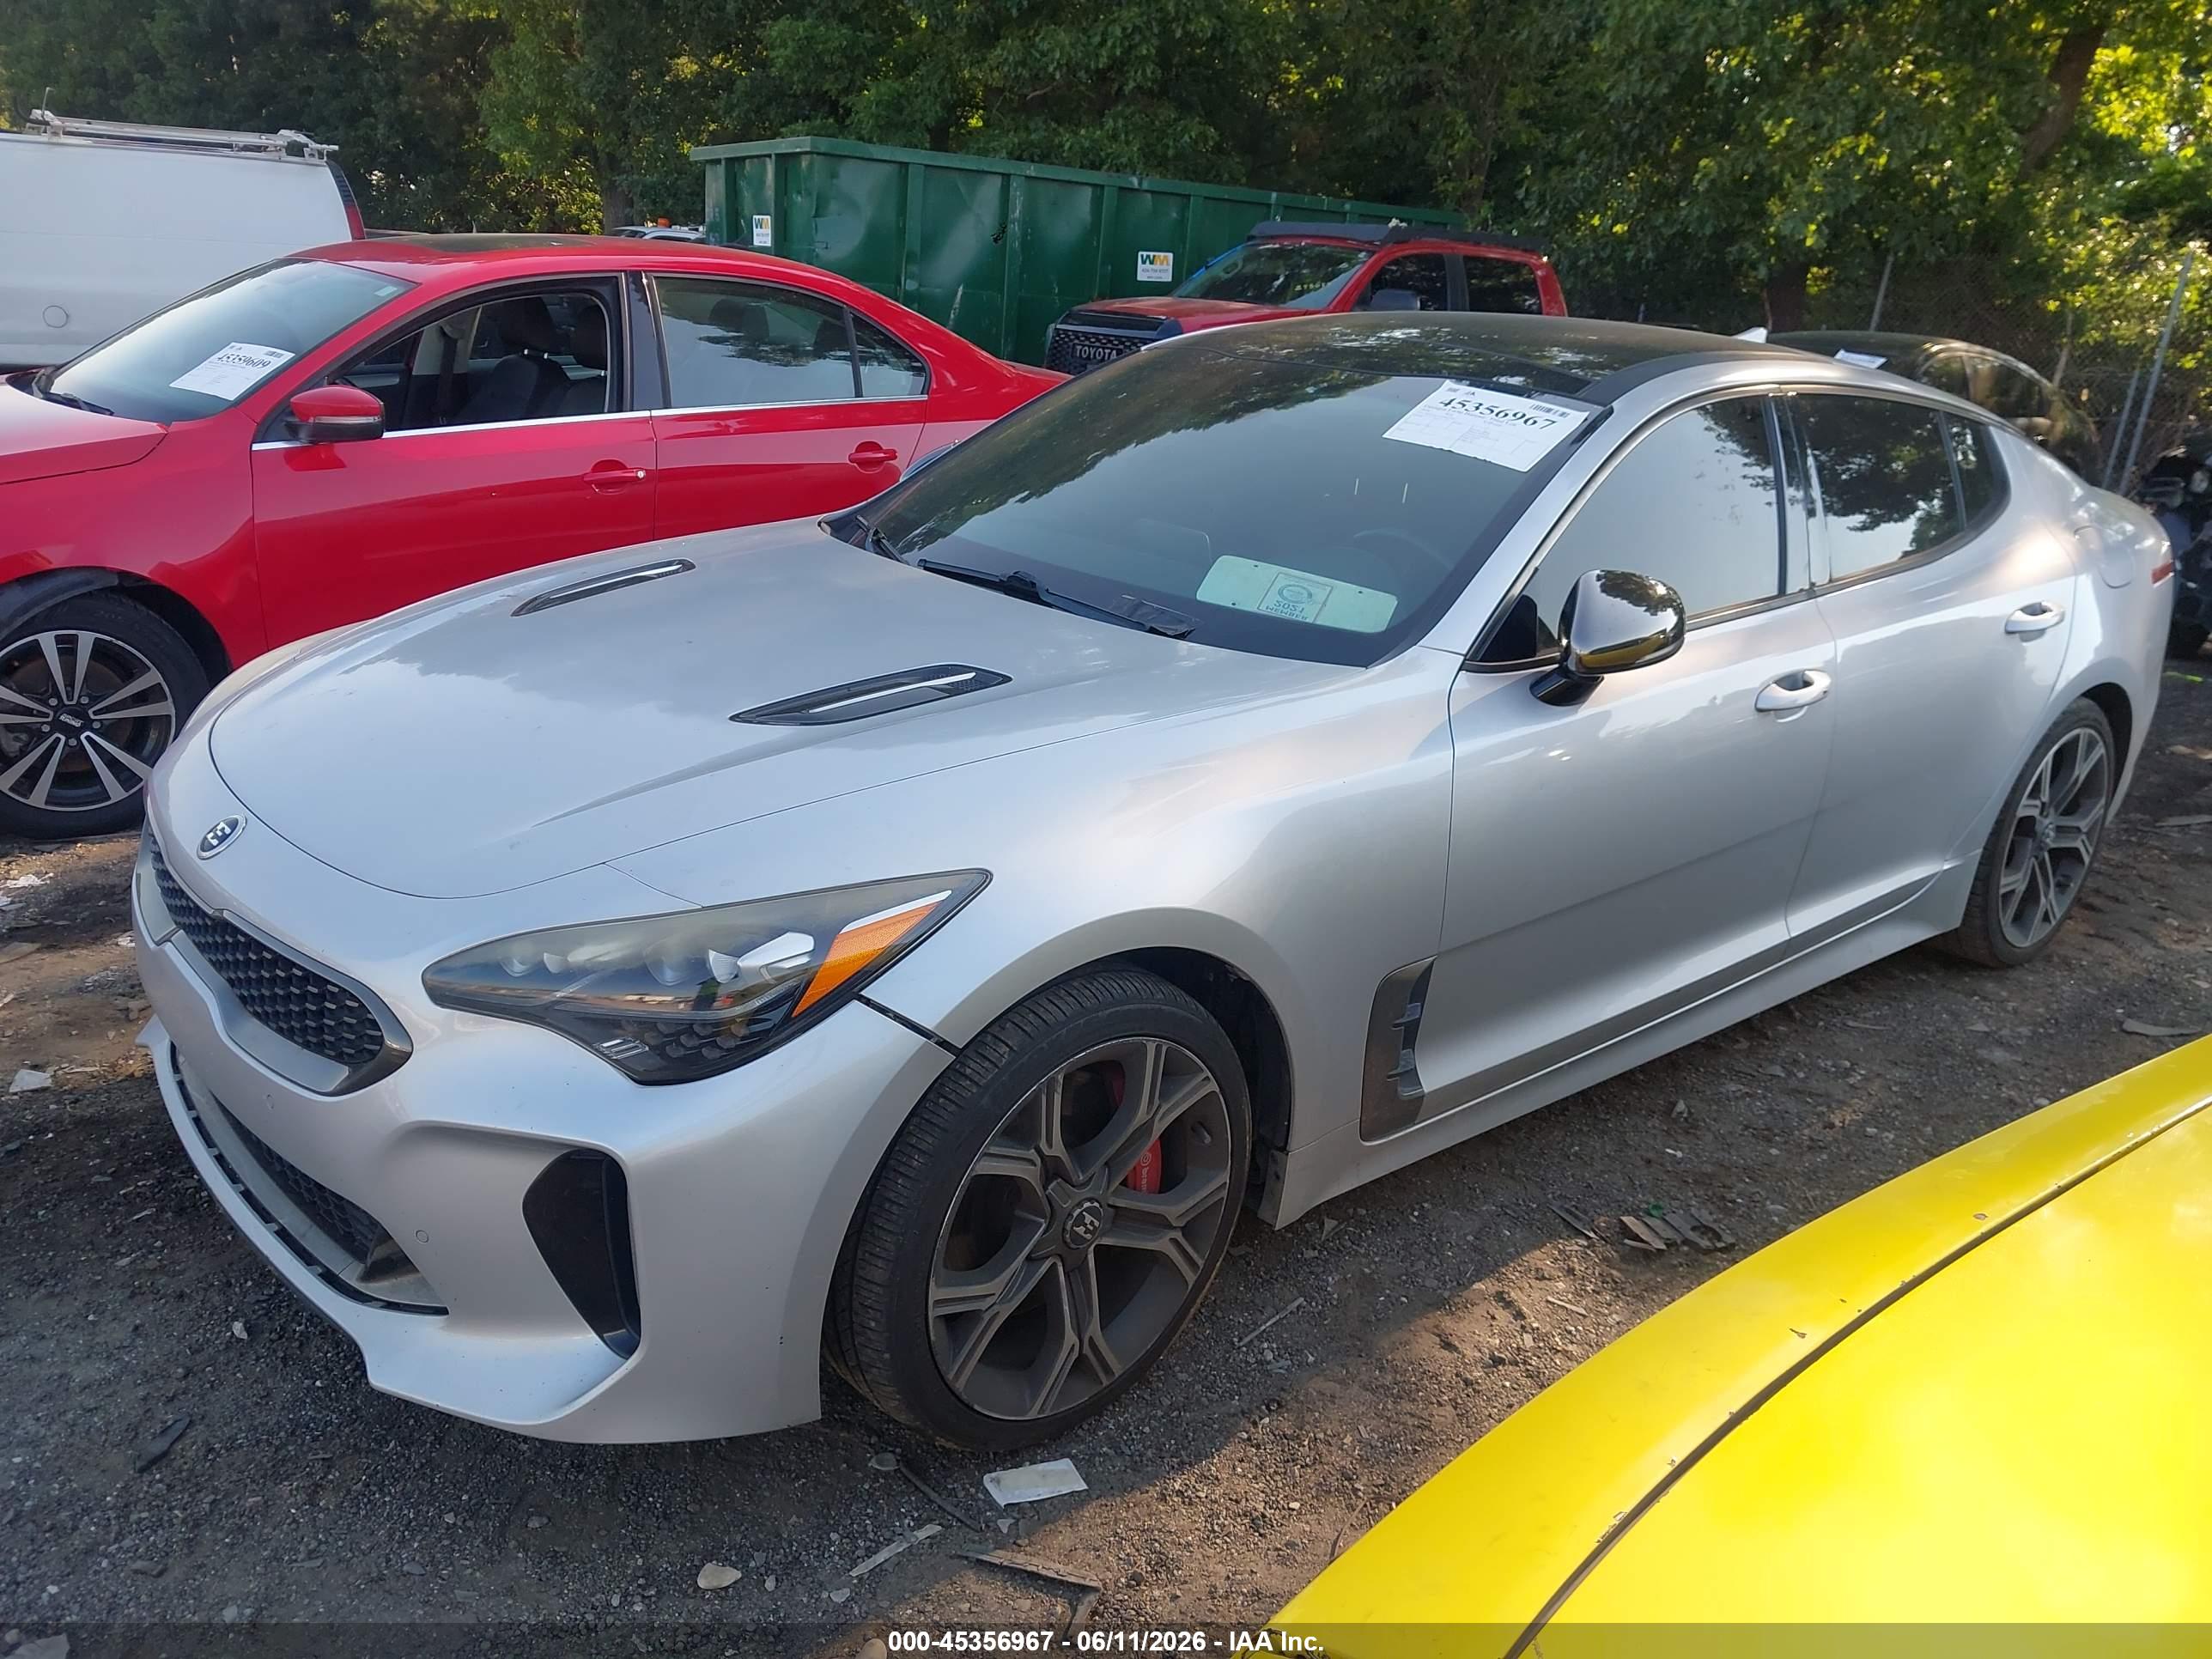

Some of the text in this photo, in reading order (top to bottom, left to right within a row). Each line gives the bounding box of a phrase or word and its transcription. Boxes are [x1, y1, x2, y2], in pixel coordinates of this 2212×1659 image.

[1140, 254, 1169, 266] WM
[1076, 345, 1117, 360] TOYOTA
[1438, 398, 1559, 430] 45356967
